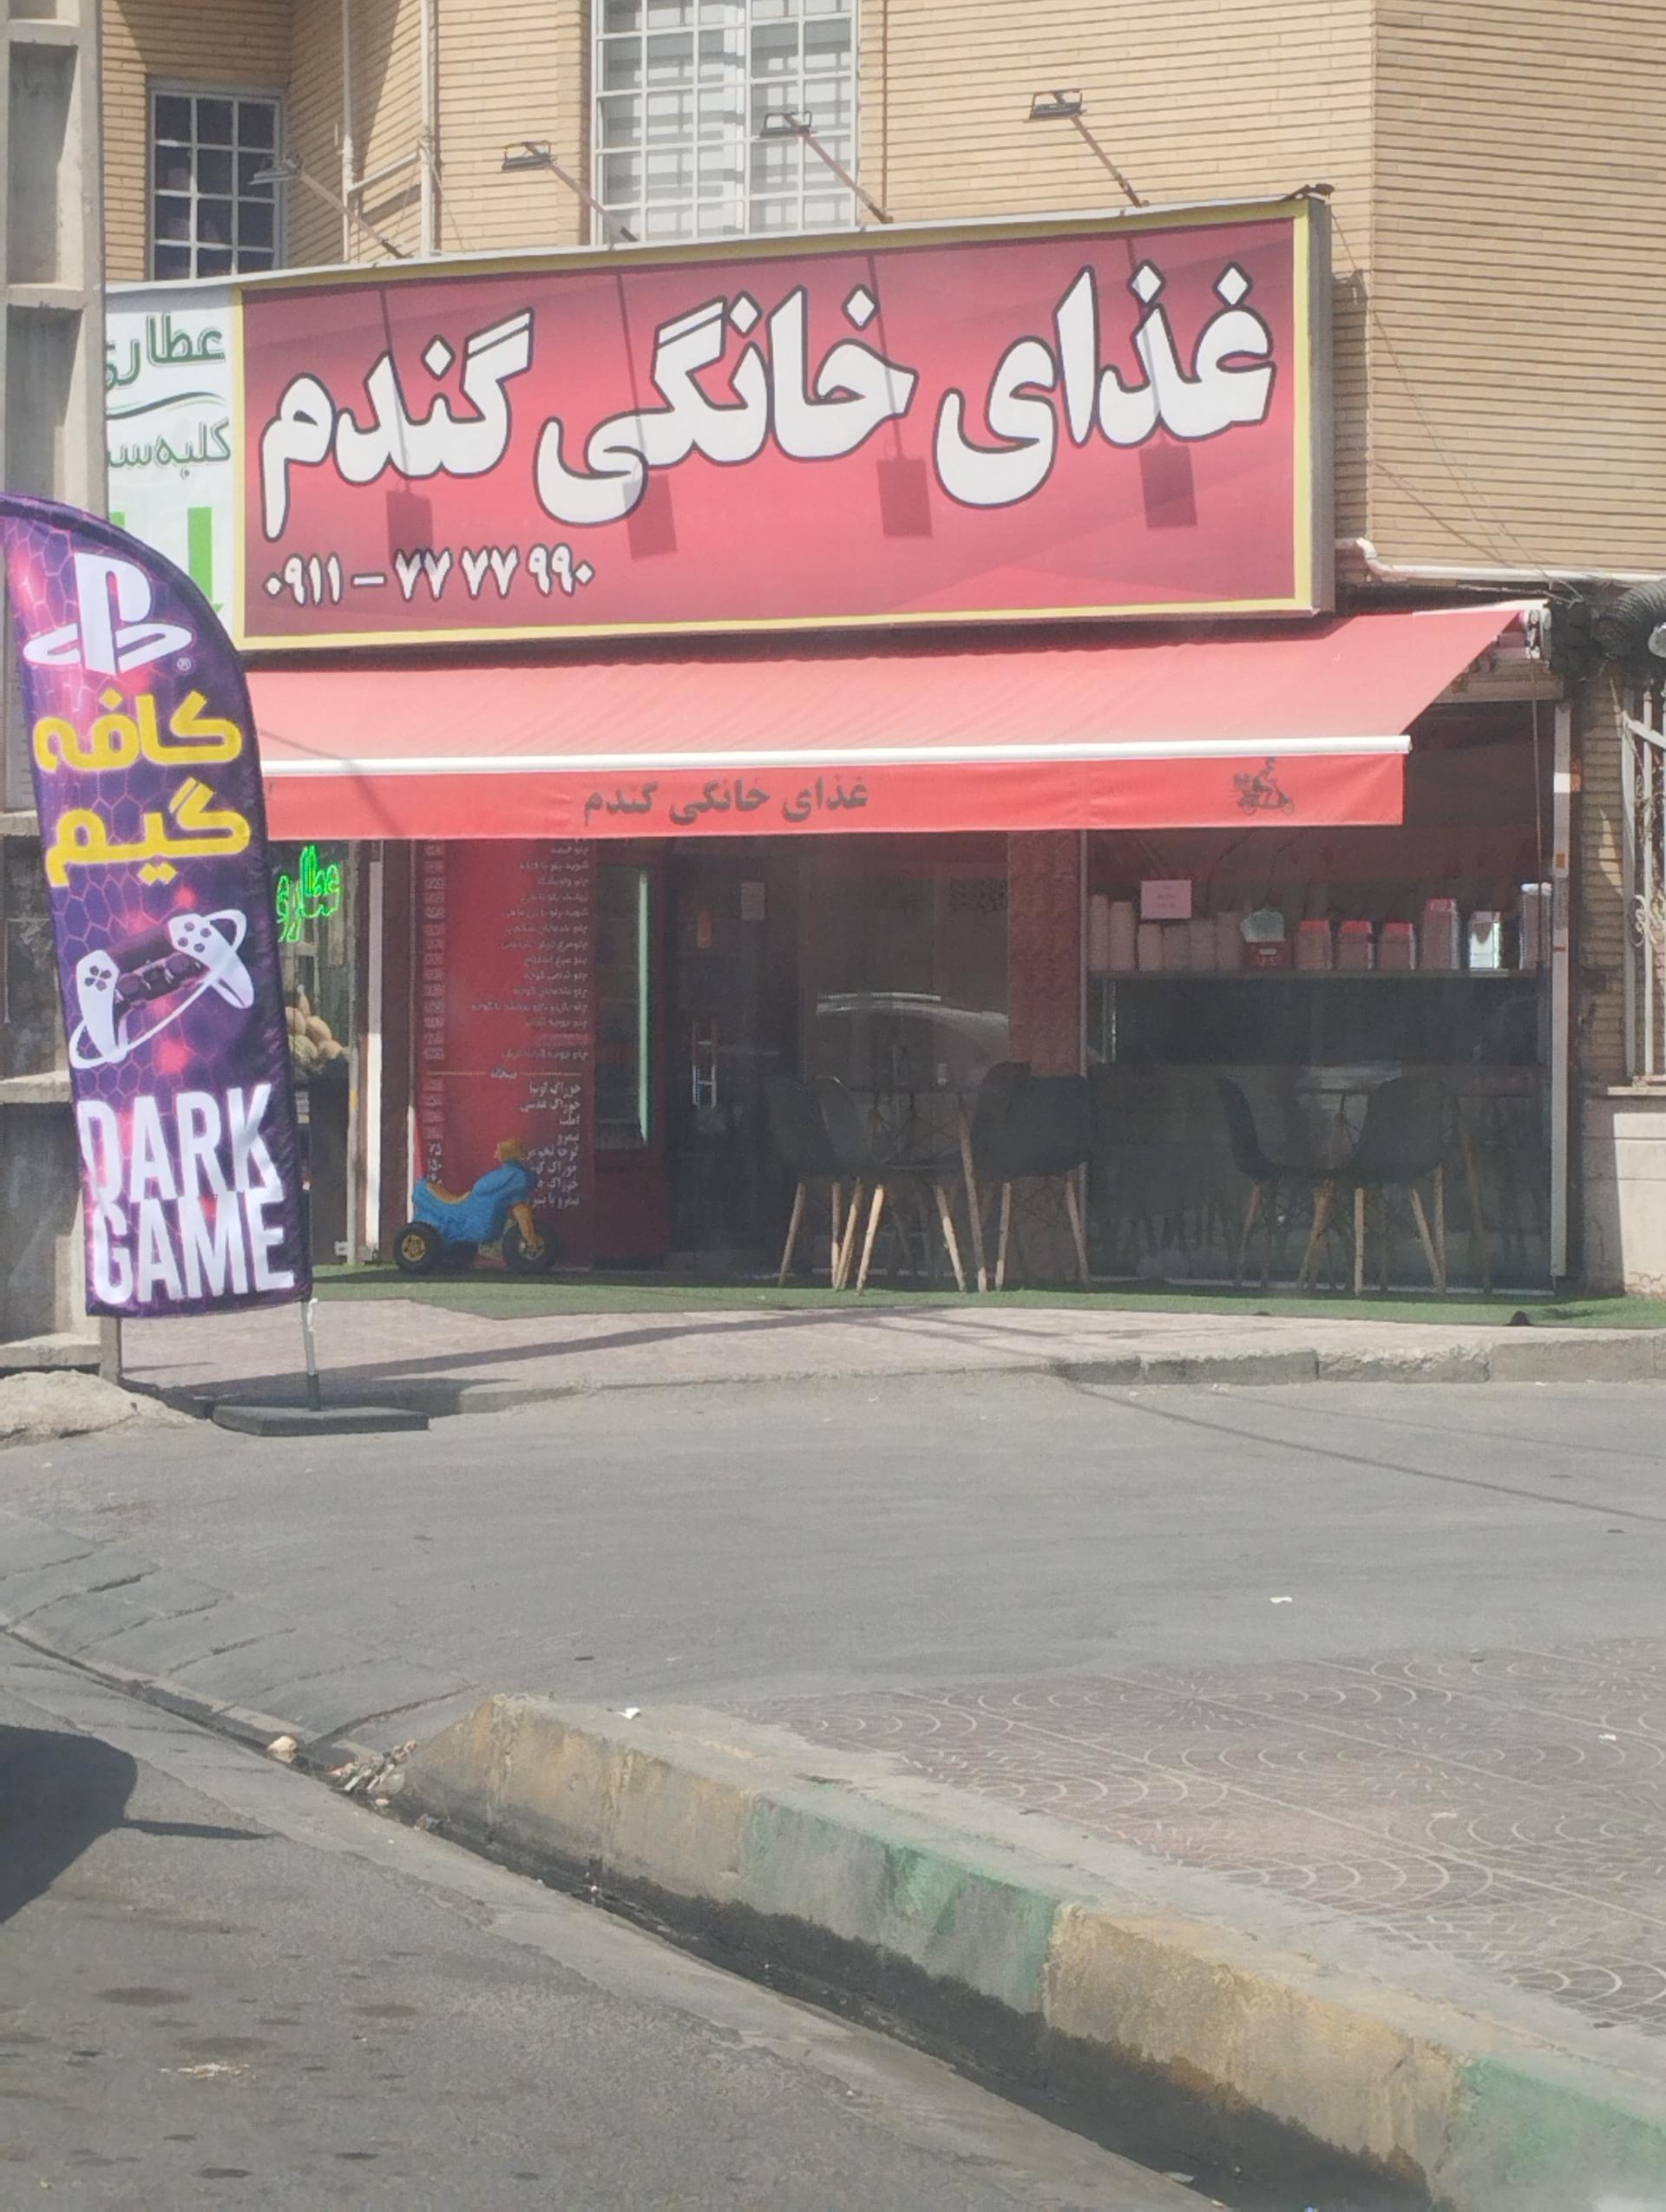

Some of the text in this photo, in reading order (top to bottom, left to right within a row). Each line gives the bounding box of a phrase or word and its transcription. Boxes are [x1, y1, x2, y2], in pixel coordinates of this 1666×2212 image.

[106, 416, 231, 480] کلبه س
[260, 259, 1276, 543] غذای خانگی گندم
[33, 688, 243, 773] کافه
[45, 777, 252, 888] گیم
[584, 780, 659, 828] گندم
[782, 773, 869, 823] غذای
[277, 845, 340, 943] عطاری
[76, 1083, 285, 1204] DARK
[93, 1188, 295, 1305] GAME
